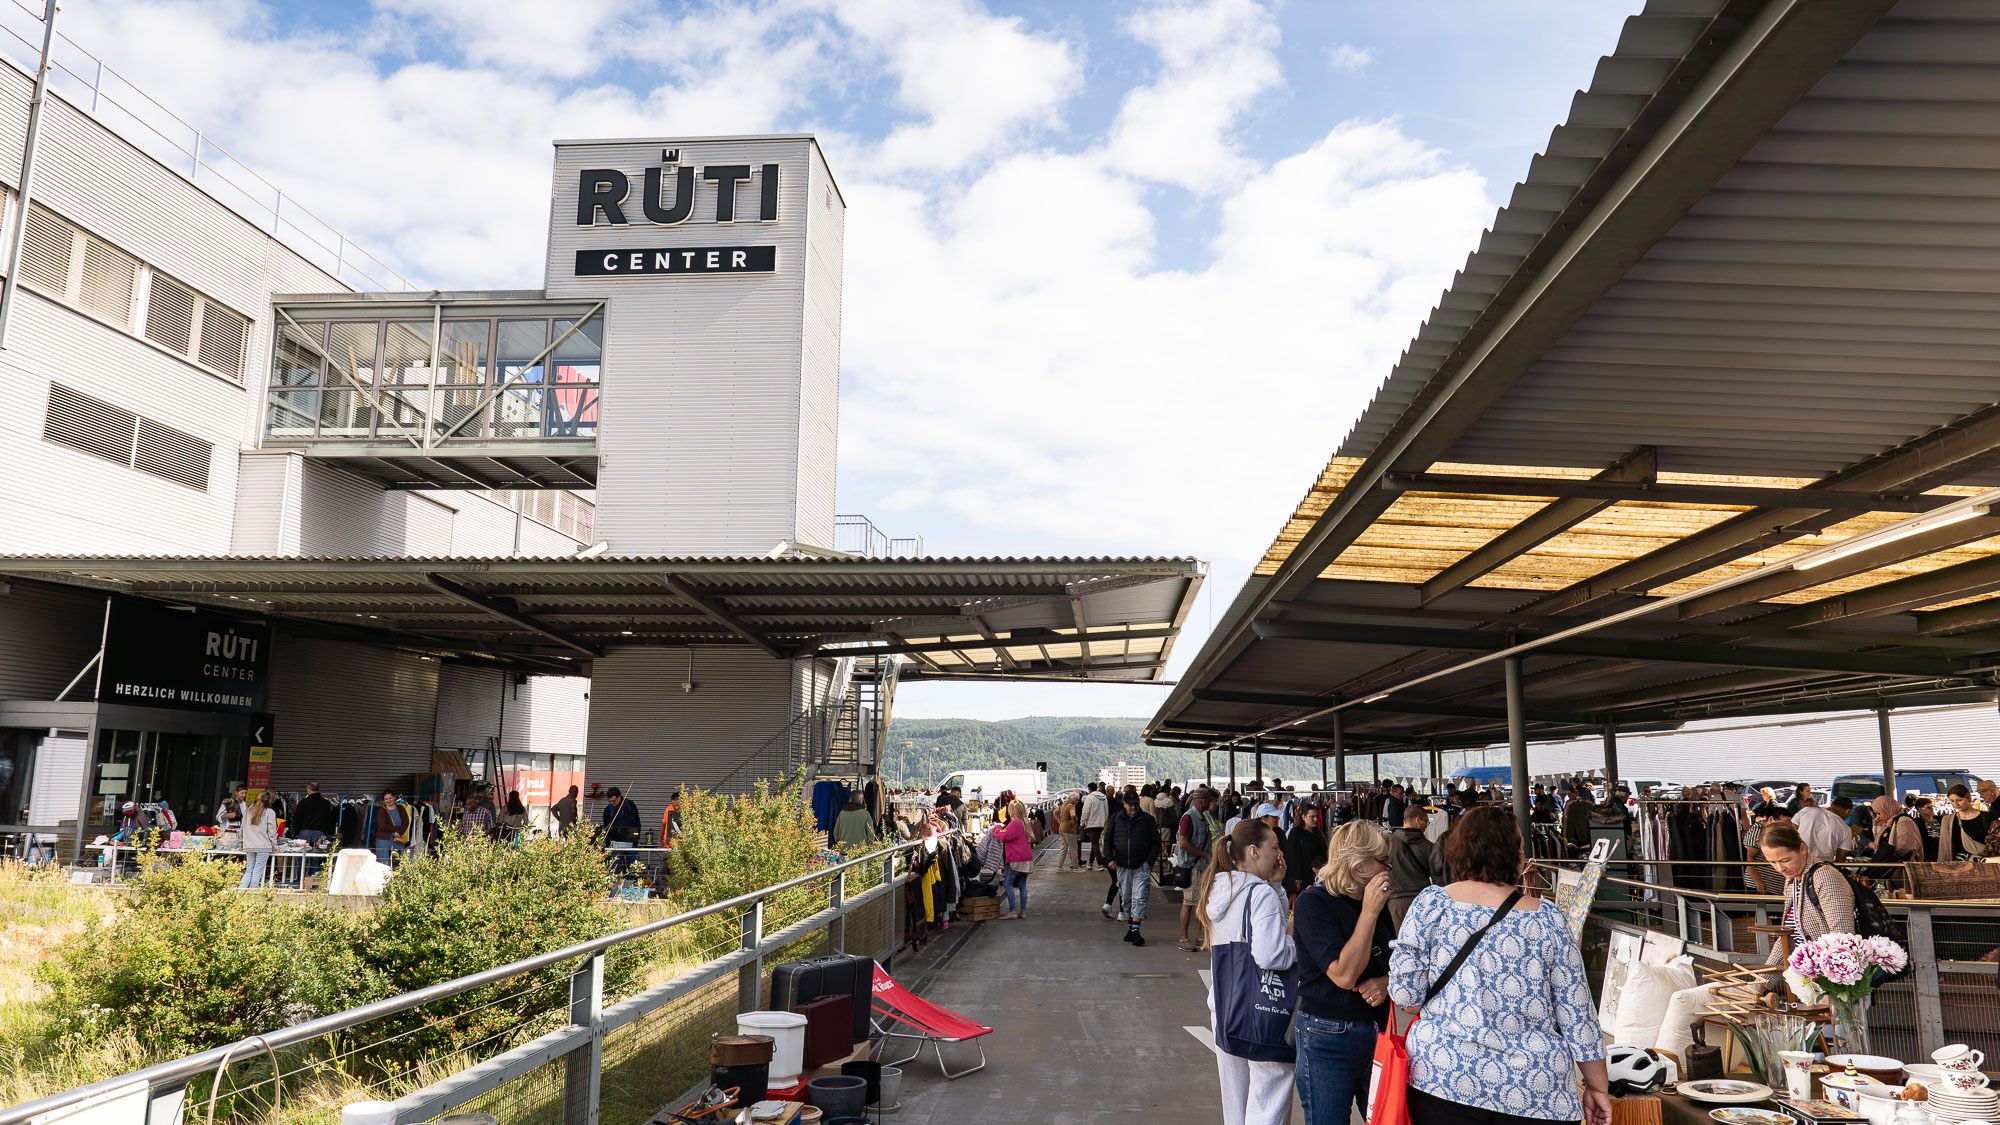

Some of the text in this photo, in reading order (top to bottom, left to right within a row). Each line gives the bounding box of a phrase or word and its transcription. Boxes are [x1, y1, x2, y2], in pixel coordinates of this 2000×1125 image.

[602, 250, 748, 272] CENTER
[203, 663, 255, 681] CENTER
[115, 682, 253, 707] HERZLICH WILLKOMMEN
